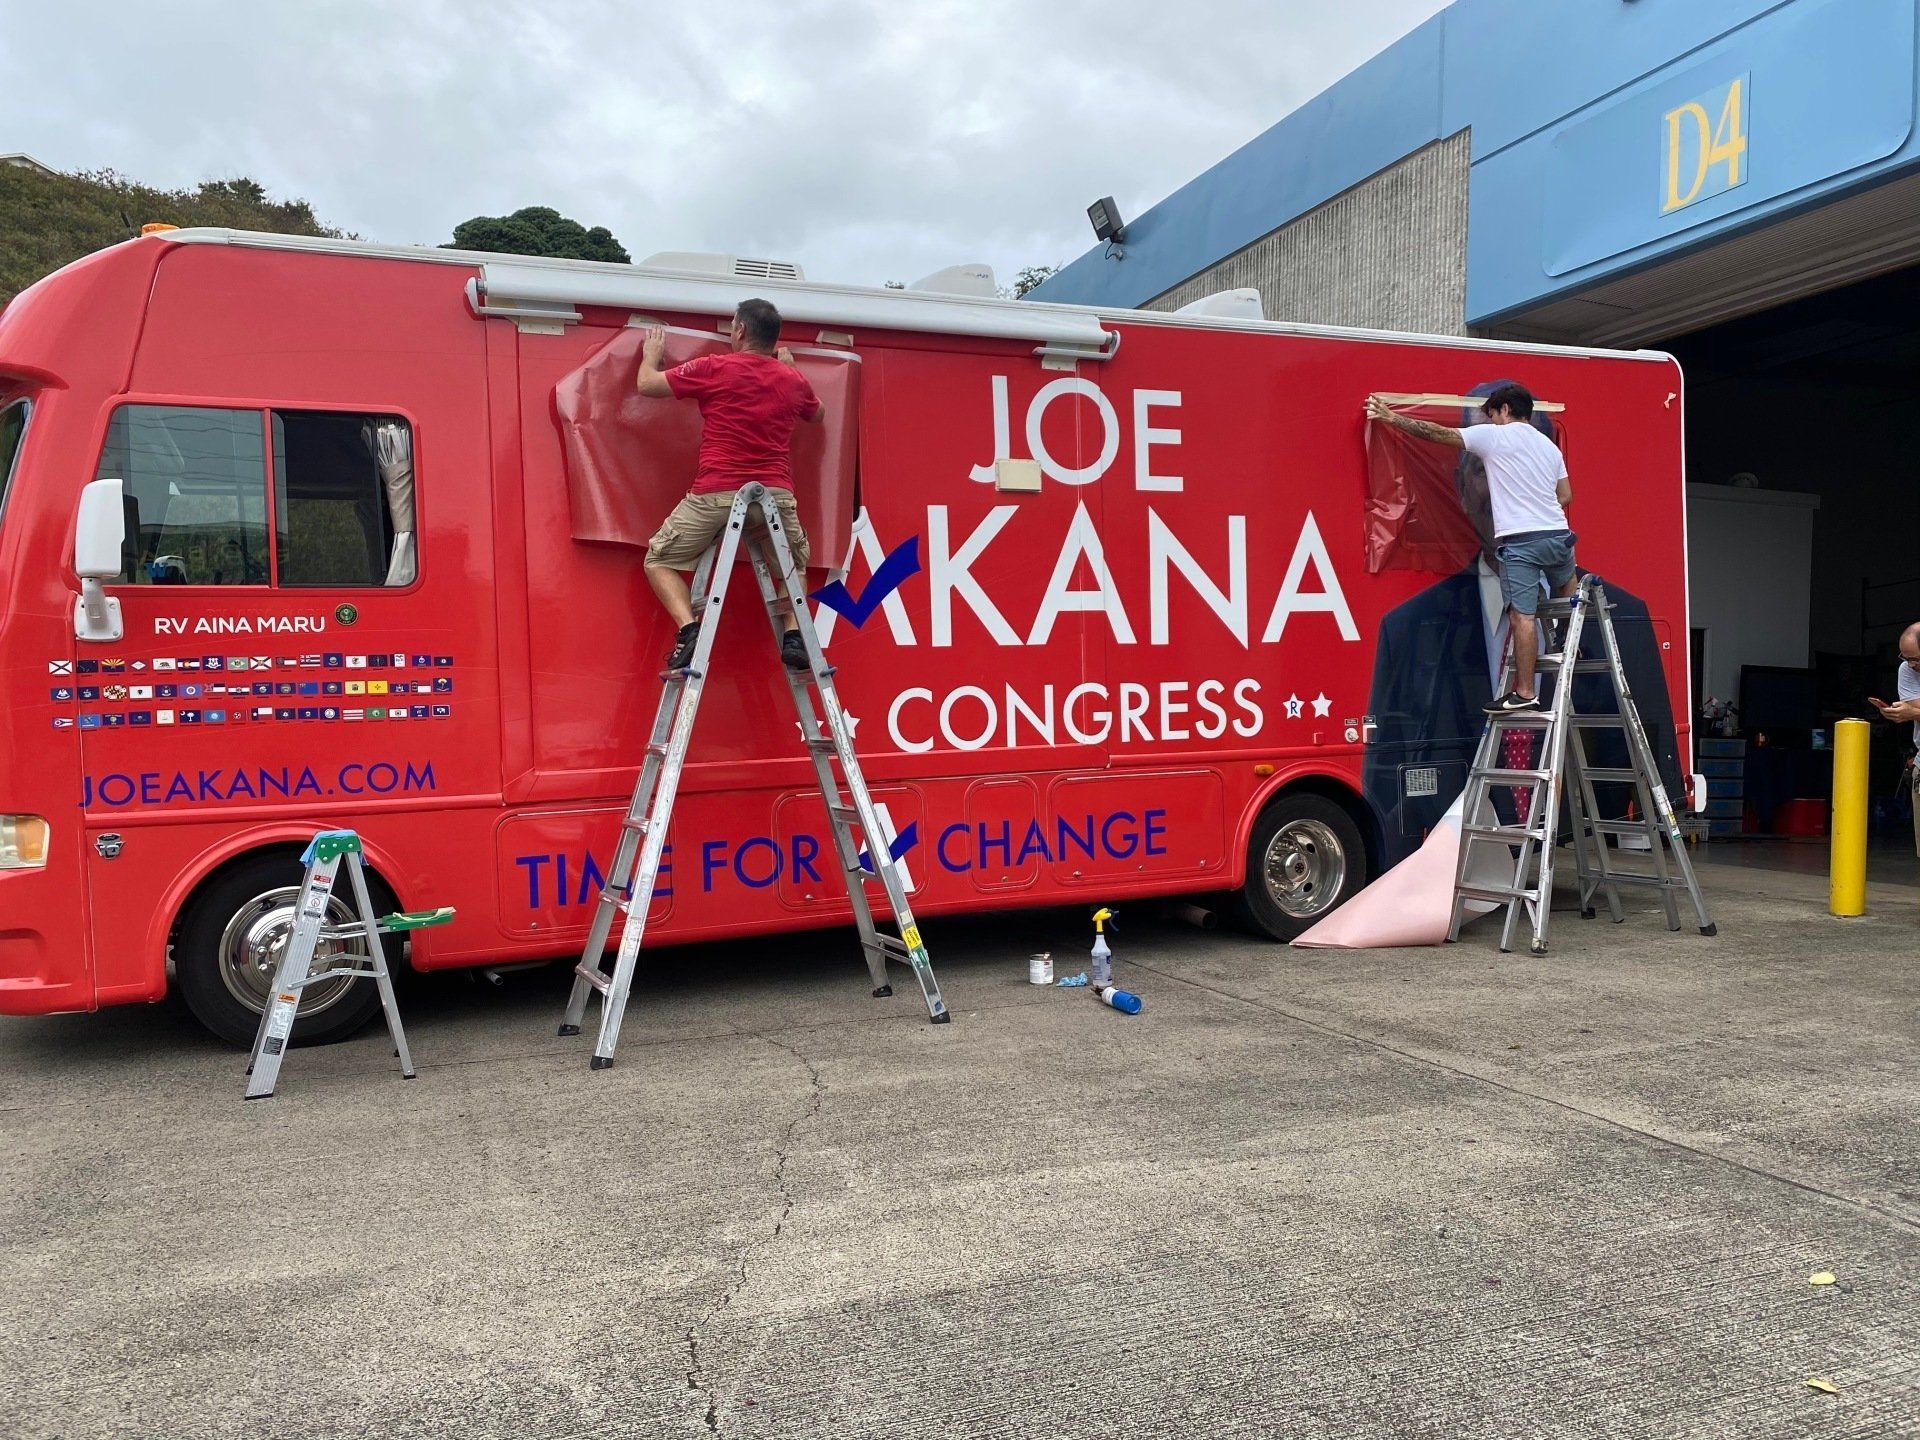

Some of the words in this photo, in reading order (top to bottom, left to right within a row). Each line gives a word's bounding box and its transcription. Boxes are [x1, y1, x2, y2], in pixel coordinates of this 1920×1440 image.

[1663, 79, 1746, 212] D4
[967, 375, 1184, 492] JOE
[813, 499, 1361, 650] AKANA
[154, 617, 189, 634] RV
[193, 616, 253, 634] AINA
[257, 616, 326, 633] MARU
[887, 678, 1264, 753] CONGRESS
[78, 760, 436, 807] JOEAKANA.COM
[703, 834, 821, 891] FOR
[938, 809, 1167, 872] CHANGE
